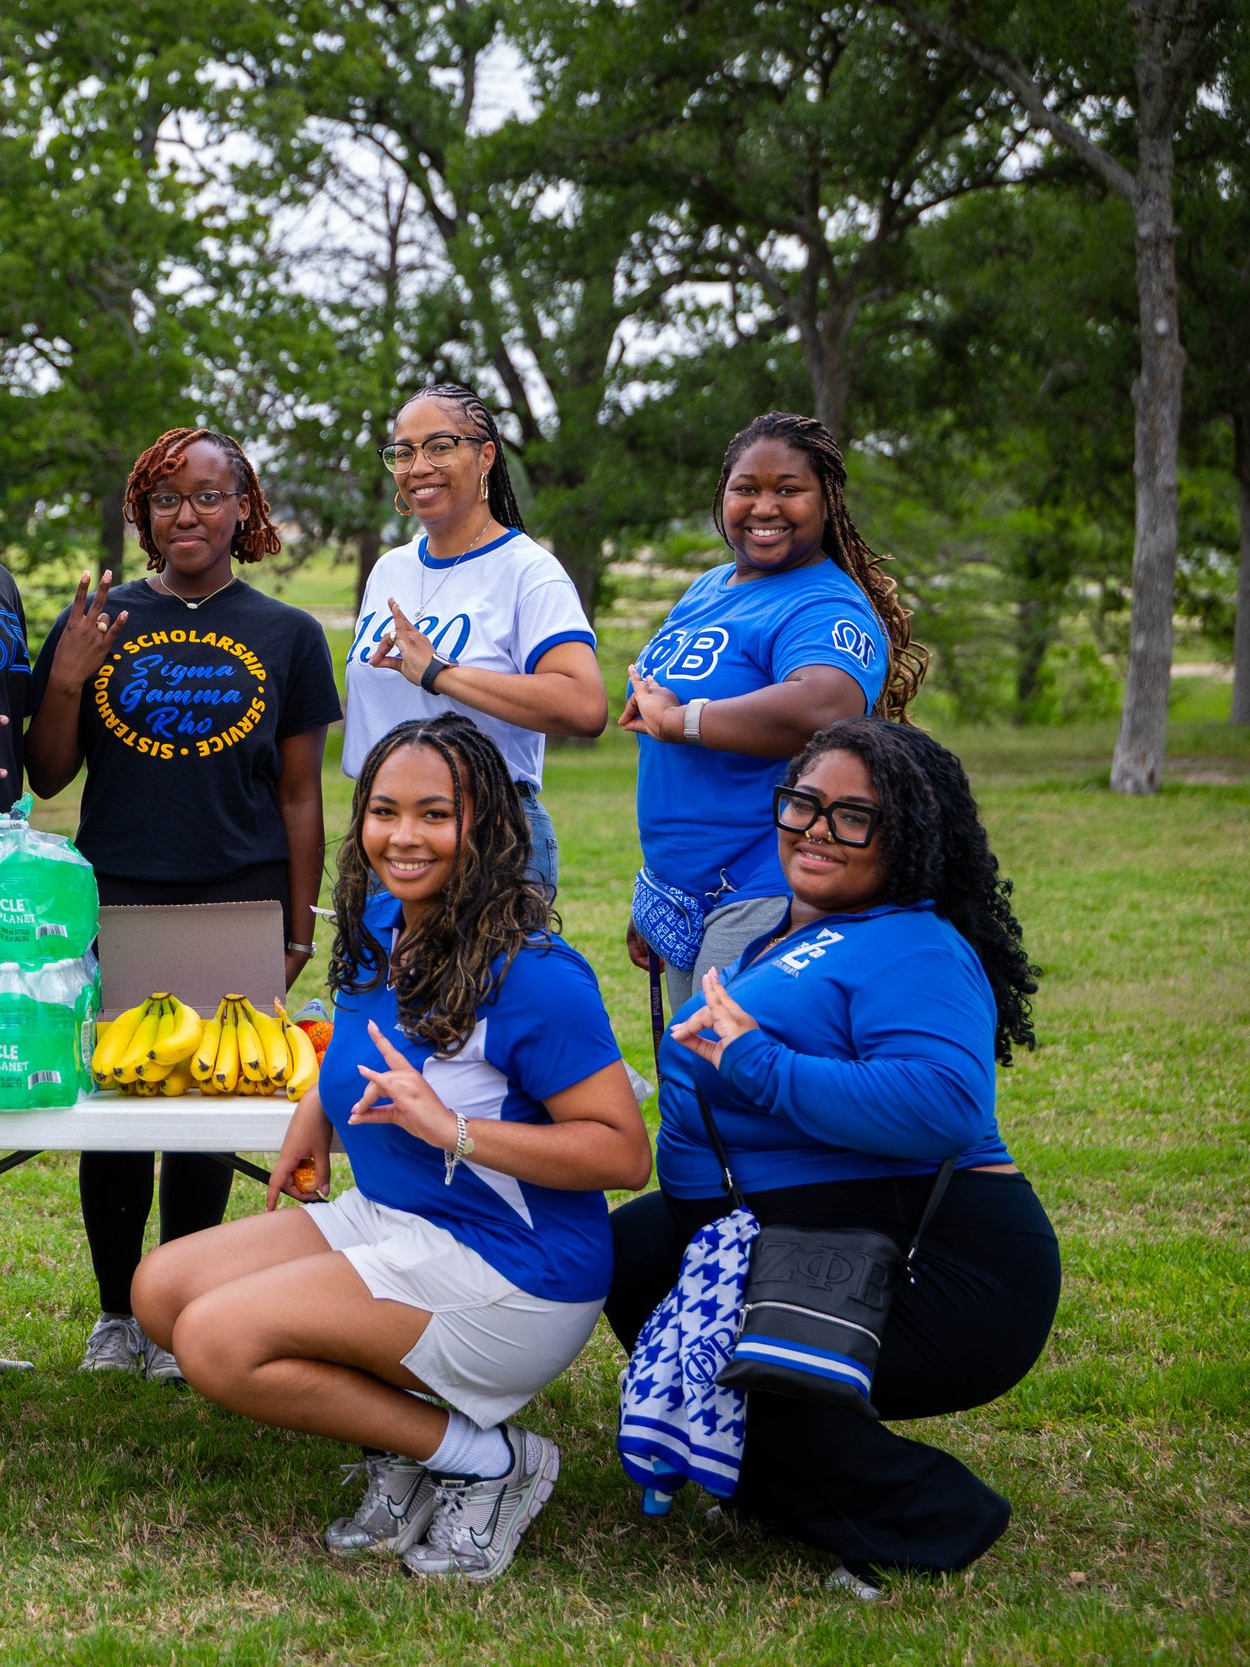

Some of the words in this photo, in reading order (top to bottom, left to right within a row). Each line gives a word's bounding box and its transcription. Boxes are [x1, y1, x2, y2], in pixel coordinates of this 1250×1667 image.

[123, 629, 267, 681] SCHOLARSHIP
[130, 654, 237, 686] Sigma
[94, 664, 175, 759] SISTERHOOD
[120, 679, 243, 713] Gamma
[145, 706, 213, 739] Rho
[196, 697, 266, 757] SERVICE
